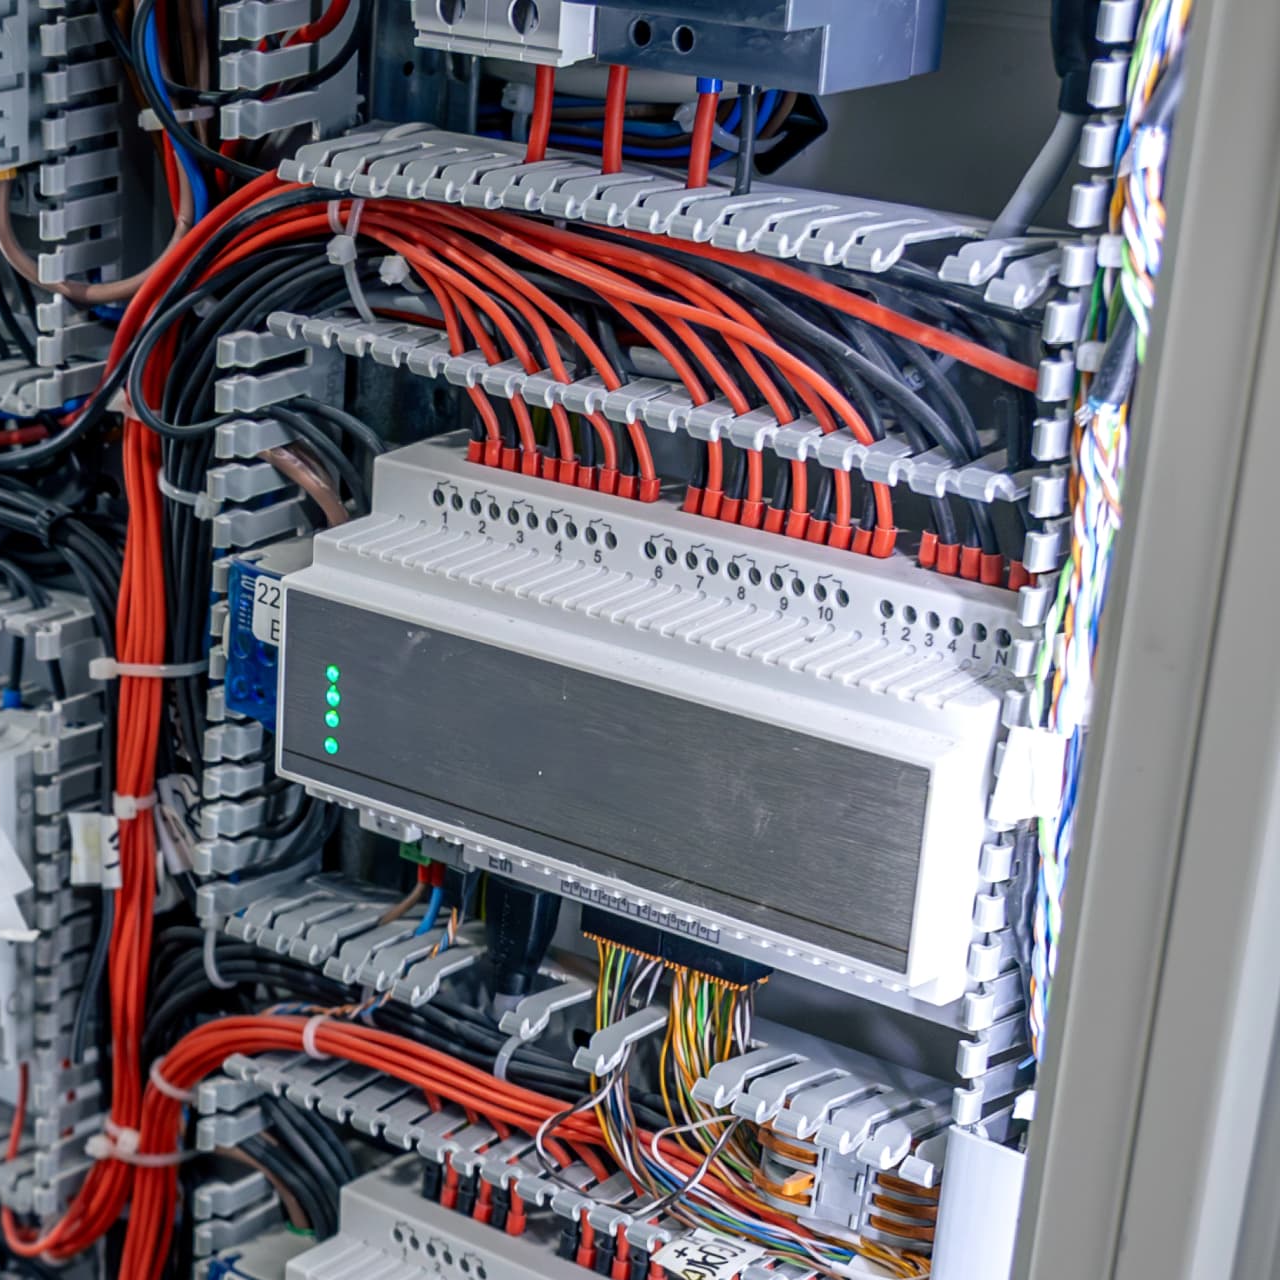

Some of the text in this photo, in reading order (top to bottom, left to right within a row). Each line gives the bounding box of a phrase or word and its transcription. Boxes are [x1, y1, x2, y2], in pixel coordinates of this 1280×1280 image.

[441, 511, 602, 563] 1 2 3 4 5
[654, 566, 833, 621] 6 7 8 9 10
[880, 623, 1007, 666] 1 2 3 4 L N
